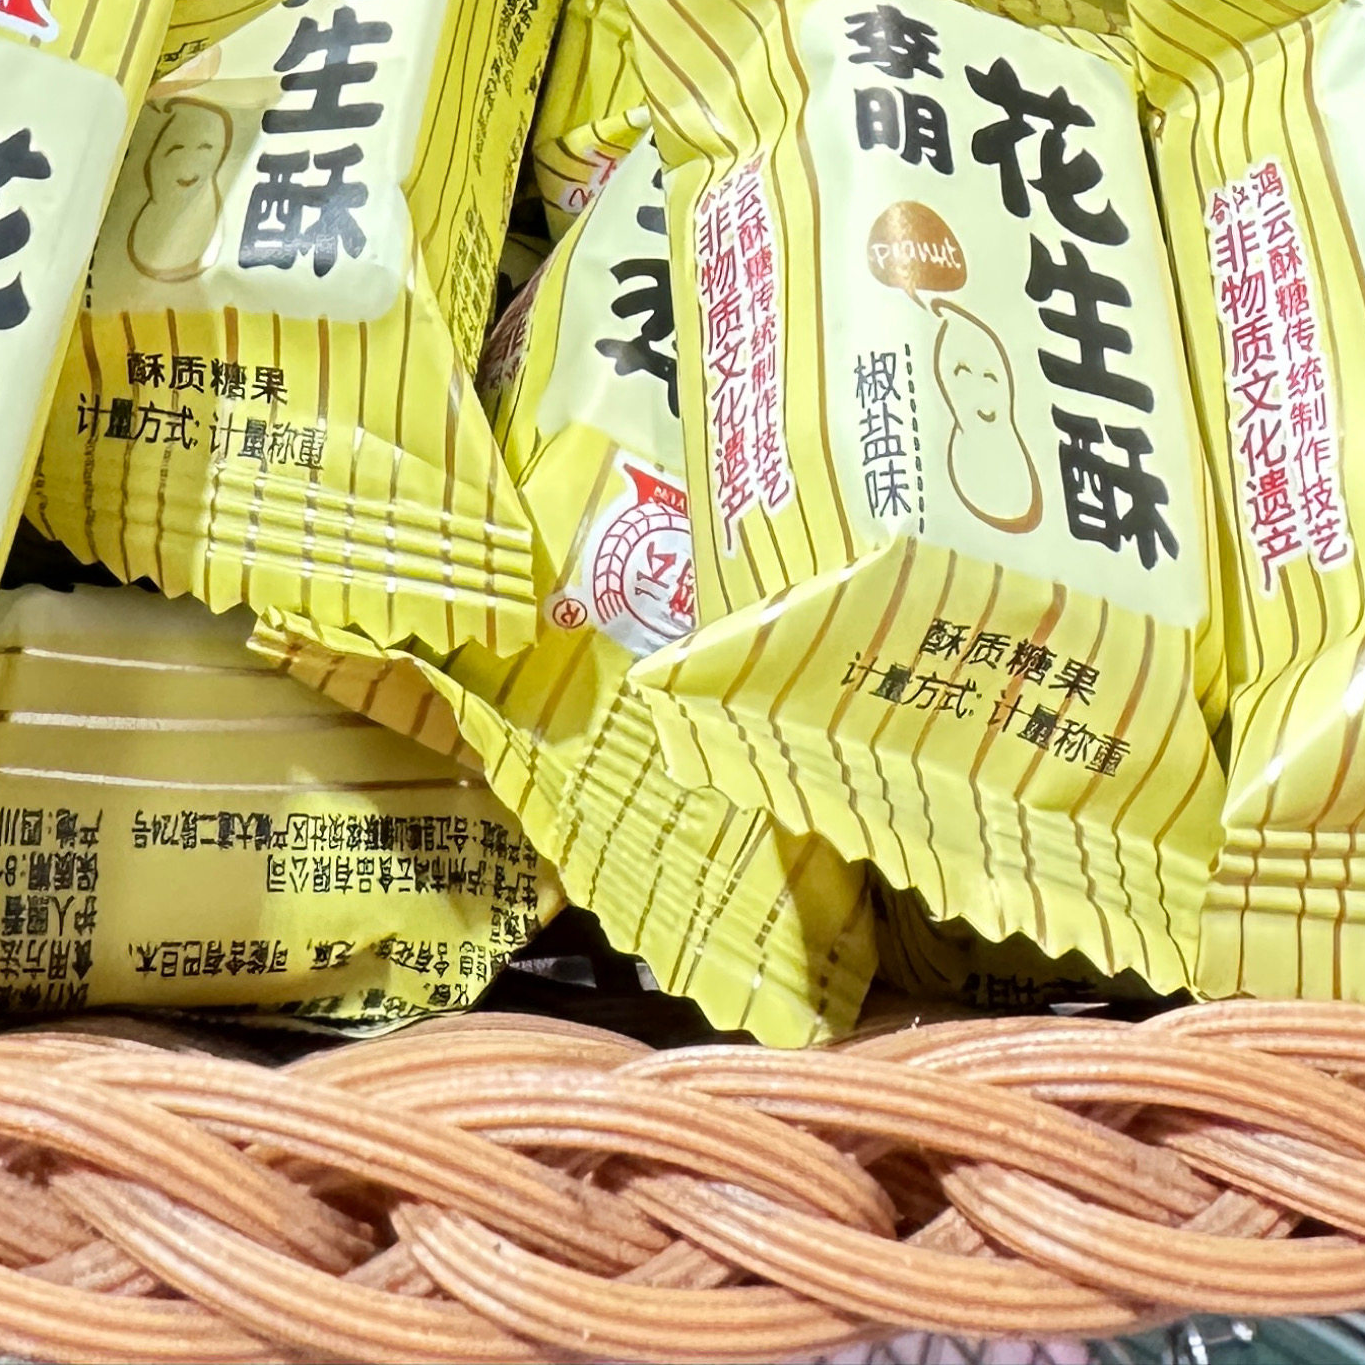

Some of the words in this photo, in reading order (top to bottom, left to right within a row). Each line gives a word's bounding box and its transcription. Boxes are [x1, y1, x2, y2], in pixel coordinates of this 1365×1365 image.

[844, 3, 957, 176] 李明
[125, 350, 289, 406] 酥质糖果
[963, 57, 1180, 571] 花生酥
[1251, 161, 1350, 566] 鸿云酥糖传统制作技艺
[853, 349, 914, 522] 椒盐味
[919, 617, 1102, 708] 酥质糖果
